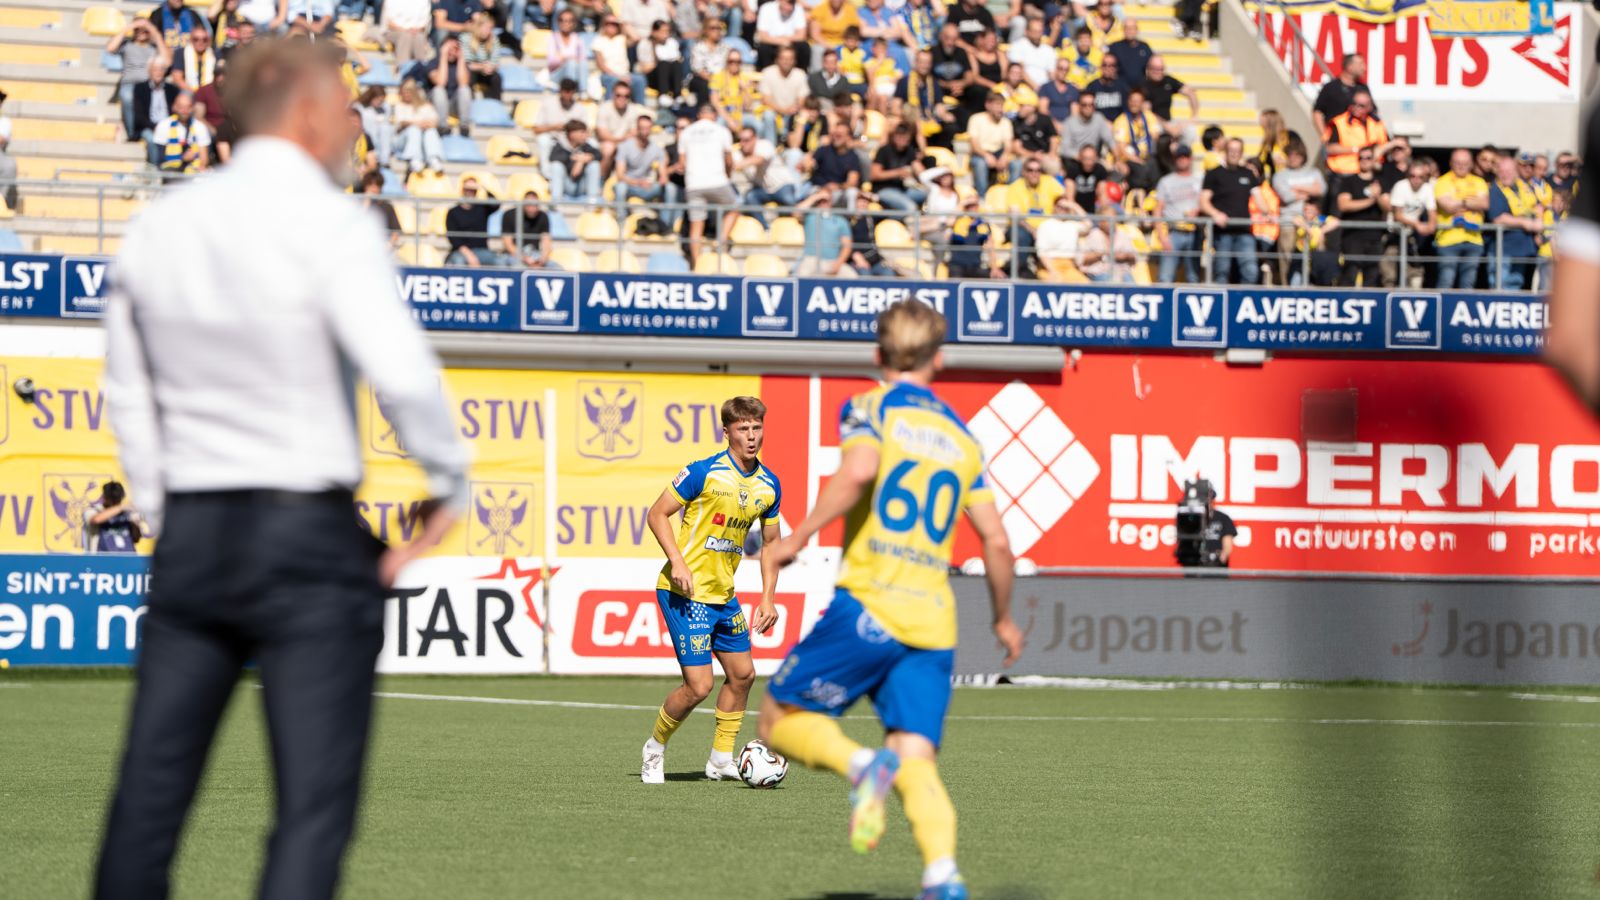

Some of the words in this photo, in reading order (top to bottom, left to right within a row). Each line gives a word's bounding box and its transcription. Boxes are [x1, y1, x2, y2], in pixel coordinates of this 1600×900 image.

[1254, 12, 1489, 87] MATHYS
[535, 279, 565, 310] V
[587, 280, 733, 311] A.VERELST
[755, 284, 785, 316] V
[971, 290, 1000, 321] V
[1021, 291, 1164, 321] A.VERELST
[599, 313, 720, 329] DEVELOPMENT
[1185, 295, 1214, 327] V
[1235, 296, 1377, 325] A.VERELST
[1399, 299, 1428, 330] V
[1033, 324, 1150, 339] DEVELOPMENT
[1247, 329, 1363, 343] DEVELOPMENT
[1462, 333, 1550, 349] DEVELOPM
[1110, 434, 1600, 508] IMPERMO
[878, 459, 961, 544] 60
[557, 505, 648, 545] STVV
[1275, 524, 1456, 552] natuursteen
[1530, 529, 1600, 559] park
[1043, 601, 1248, 663] Japanet
[1438, 608, 1600, 670] Japan
